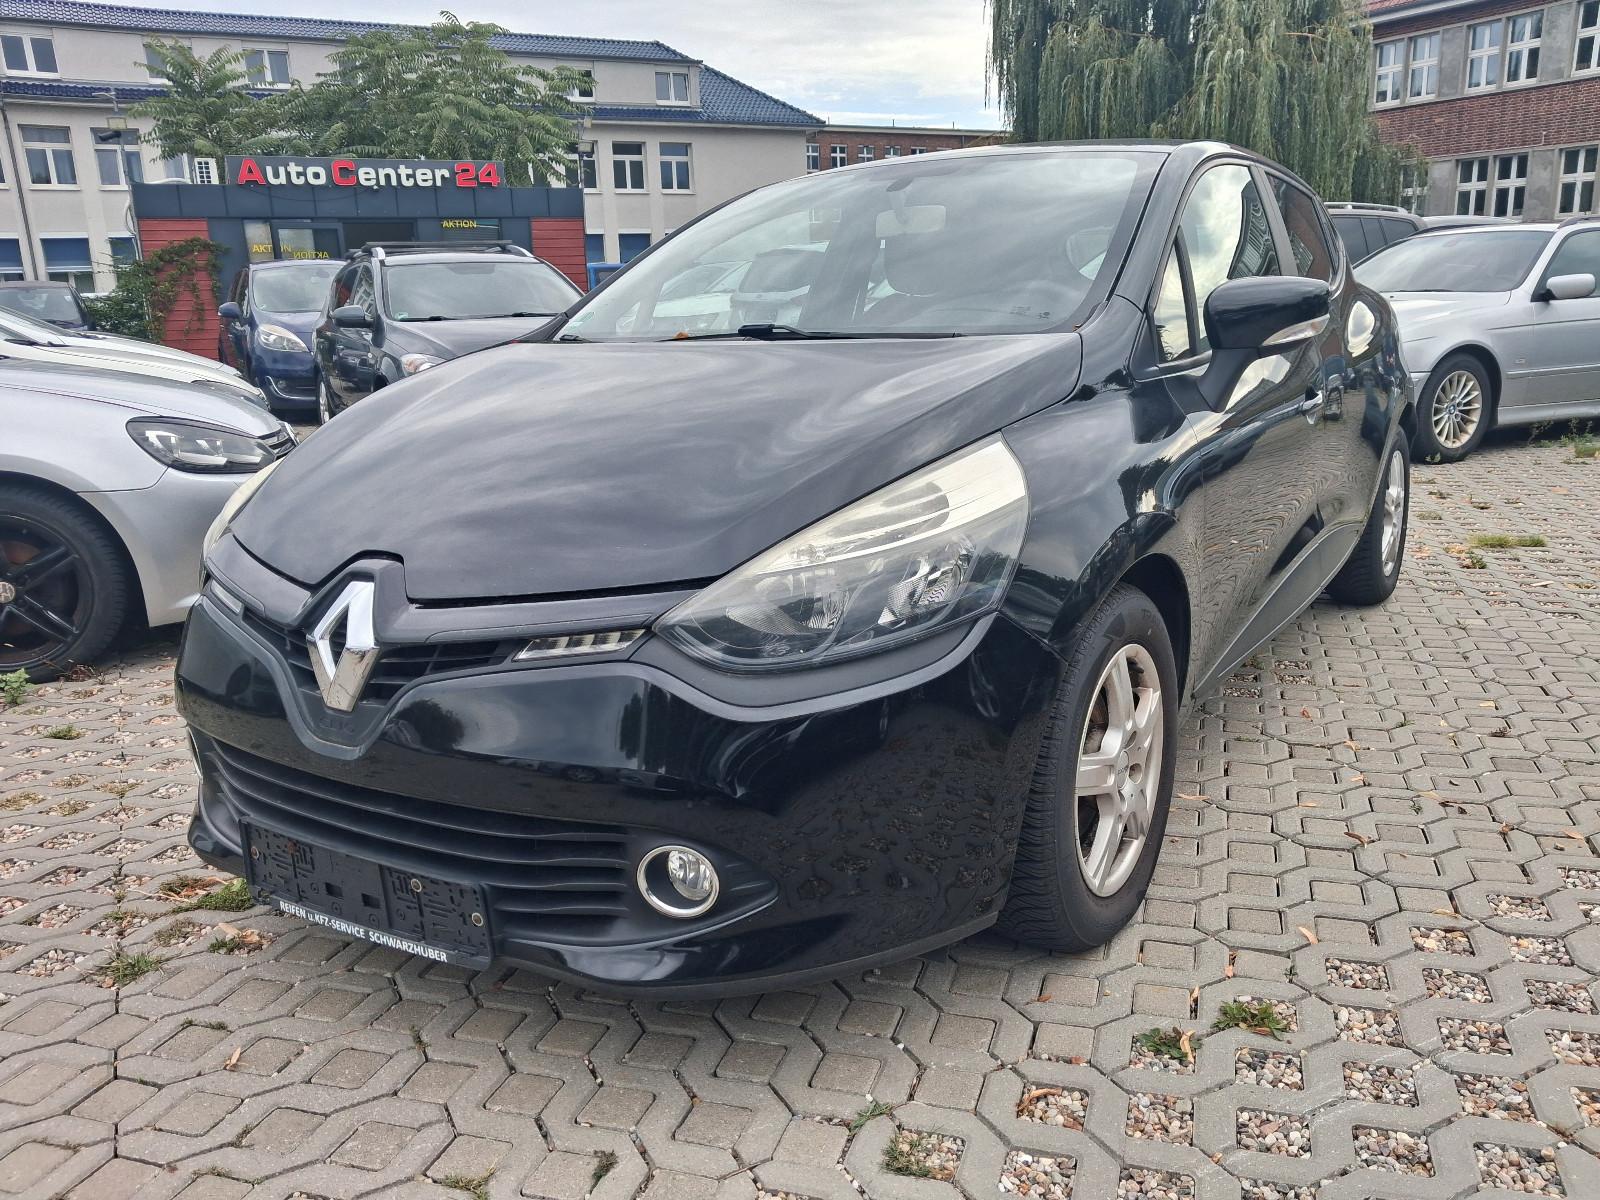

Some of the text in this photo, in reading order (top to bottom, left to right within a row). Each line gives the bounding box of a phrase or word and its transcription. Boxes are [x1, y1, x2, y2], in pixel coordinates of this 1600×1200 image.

[237, 158, 501, 187] Auto Center 24
[442, 219, 477, 229] AKTION
[279, 901, 306, 920] REIFEN
[368, 931, 448, 963] SCHWARZHUBER
